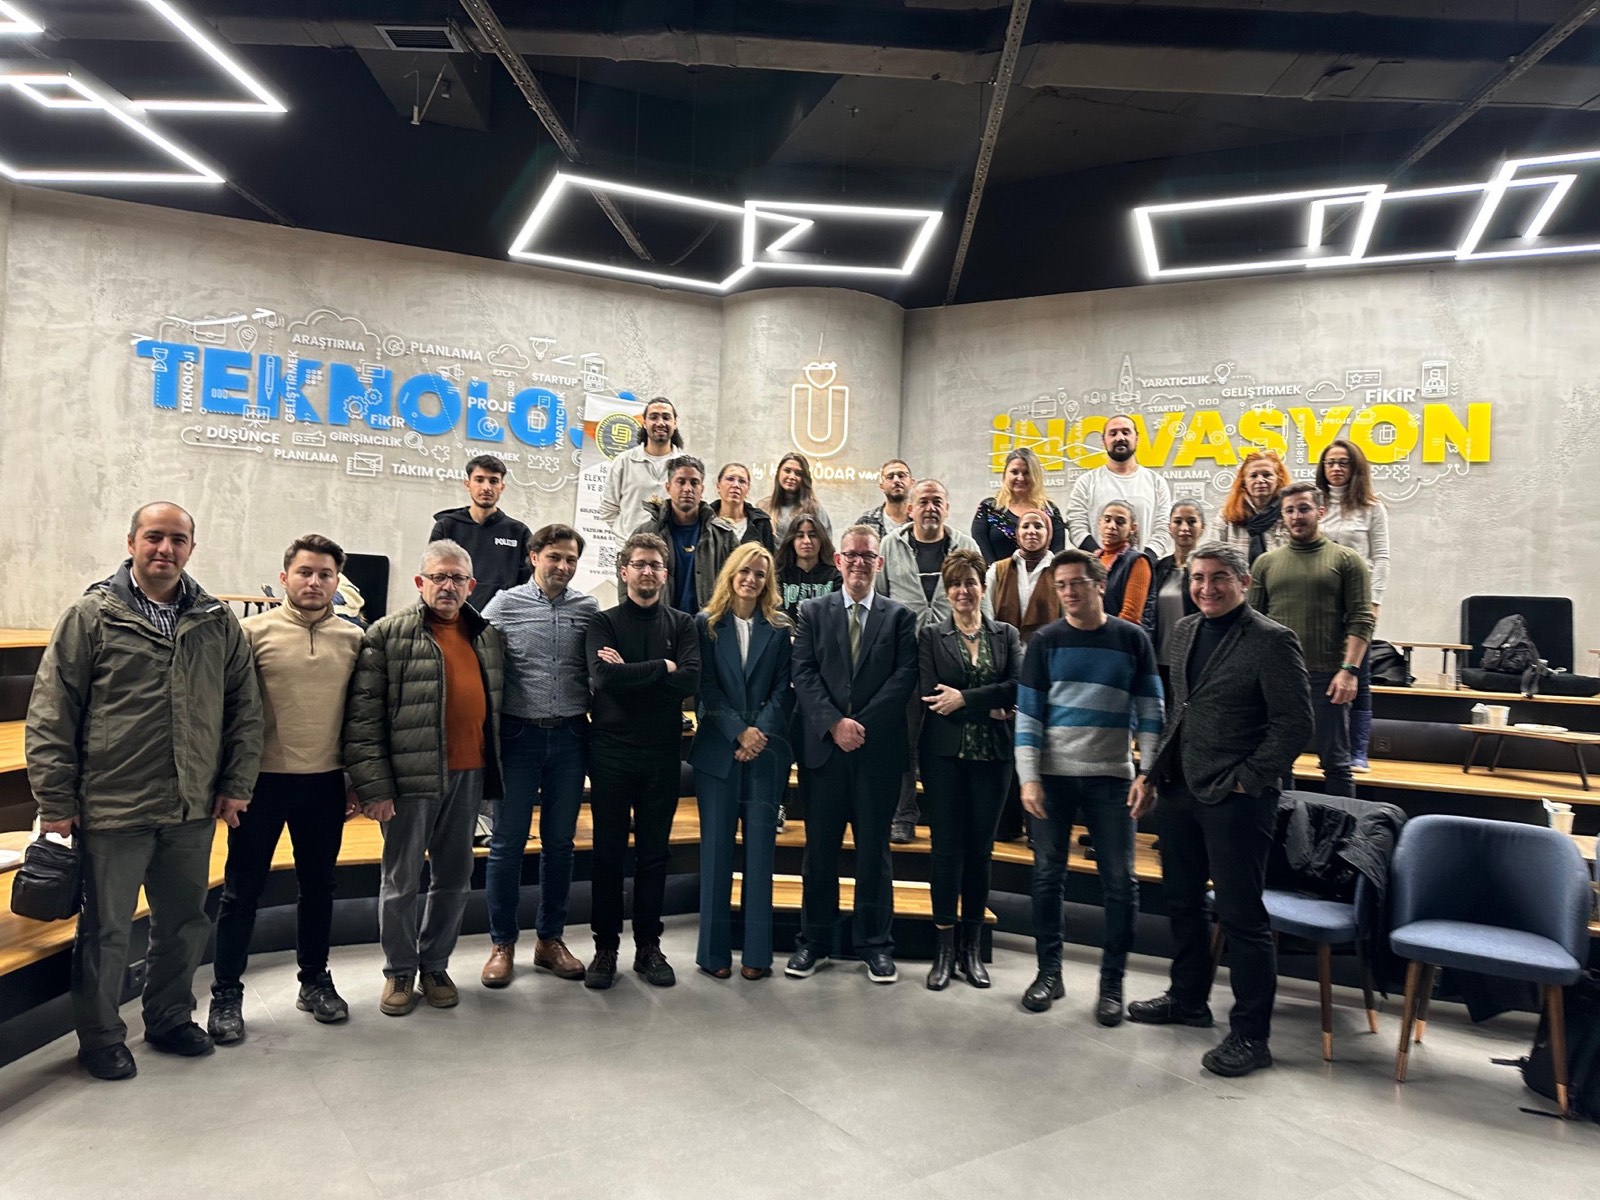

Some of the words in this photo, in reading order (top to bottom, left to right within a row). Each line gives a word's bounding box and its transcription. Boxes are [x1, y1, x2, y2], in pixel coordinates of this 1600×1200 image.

[291, 333, 365, 352] ARAŞTIRMA
[410, 341, 483, 362] PLANLAMA
[531, 372, 578, 386] STARTUP
[1141, 375, 1210, 388] YARATICILIK
[136, 339, 636, 448] TEKNOLO
[1222, 384, 1302, 399] GELİŞTİRMEK
[1365, 388, 1416, 404] FİKİR
[467, 396, 516, 414] PROJE
[1147, 404, 1188, 414] STARTUP
[370, 414, 405, 428] FİKİR
[554, 391, 566, 451] YARATICILIK
[1323, 417, 1351, 425] PROJE
[206, 425, 280, 445] DÜŞÜNCE
[329, 431, 402, 447] GİRİŞİMCİLİK
[274, 448, 339, 464] PLANLAMA
[391, 462, 434, 478] TAKIM
[810, 461, 855, 481] ÜDAR
[1162, 469, 1211, 480] ANLAMA
